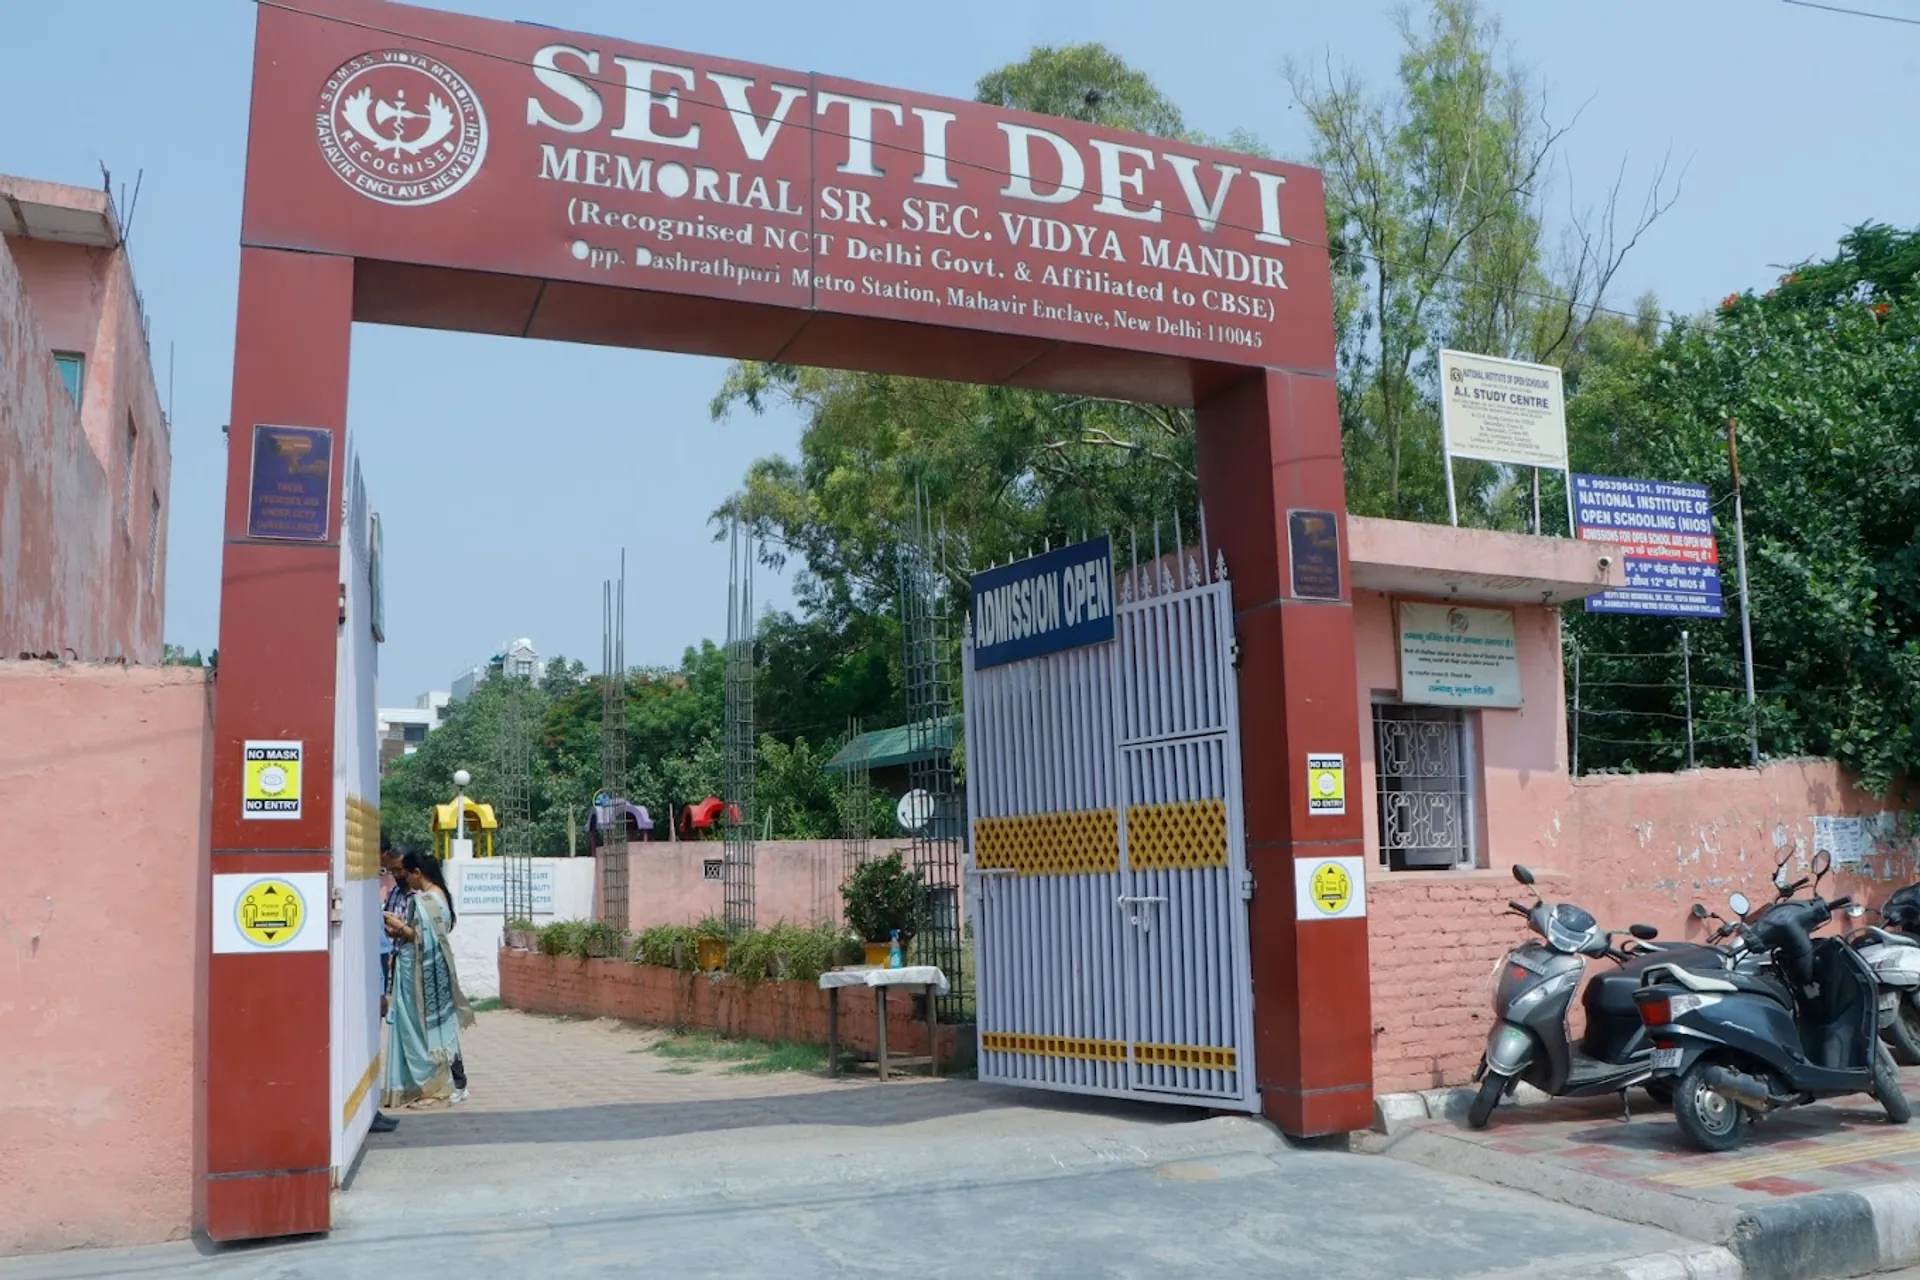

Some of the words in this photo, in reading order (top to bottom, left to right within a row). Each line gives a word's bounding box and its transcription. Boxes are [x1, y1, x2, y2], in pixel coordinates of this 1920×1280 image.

[383, 52, 427, 69] VIDYA
[431, 64, 475, 113] MANDIR
[316, 113, 356, 177] MAHAVIR
[356, 174, 431, 198] ENCLAVE
[431, 163, 464, 191] NEW
[458, 122, 480, 164] DELHI
[340, 129, 456, 175] RECOGNISED
[527, 44, 958, 189] SEVTI
[998, 121, 1291, 247] DEVI
[538, 144, 802, 216] MEMORIAL
[820, 186, 887, 228] SR.
[902, 197, 992, 241] SEC.
[999, 211, 1126, 263] VIDYA
[1140, 235, 1289, 290] MANDIR
[568, 198, 753, 245] (Recognised
[764, 226, 834, 256] NCT
[847, 238, 922, 268] Delhi
[931, 249, 1005, 279] Govt.
[1014, 262, 1032, 283] &
[1041, 265, 1164, 302] Affiliated
[1172, 286, 1196, 307] to
[1202, 289, 1275, 322] CBSE)
[571, 240, 625, 270] Opp.
[636, 247, 780, 286] Dashrathpuri
[792, 268, 856, 293] Metro
[861, 276, 941, 308] Station,
[947, 287, 1027, 316] Mahavir
[1032, 298, 1109, 330] Enclave,
[1114, 309, 1151, 332] New
[1473, 389, 1507, 404] STUDY
[1510, 394, 1549, 409] CENTRE
[1579, 491, 1635, 508] NATIONAL
[1637, 496, 1692, 514] INSTITUTE
[1695, 501, 1709, 515] OF
[1581, 509, 1611, 524] OPEN
[1614, 512, 1676, 529] SCHOOLING
[1678, 516, 1711, 535] (NIOS)
[976, 571, 1060, 649] ADMISSION
[1063, 556, 1110, 627] OPEN
[248, 750, 264, 759] NO
[267, 750, 297, 759] MASK
[1310, 760, 1321, 768] NO
[247, 800, 263, 810] NO
[264, 800, 298, 810] ENTRY
[1311, 799, 1321, 807] NO
